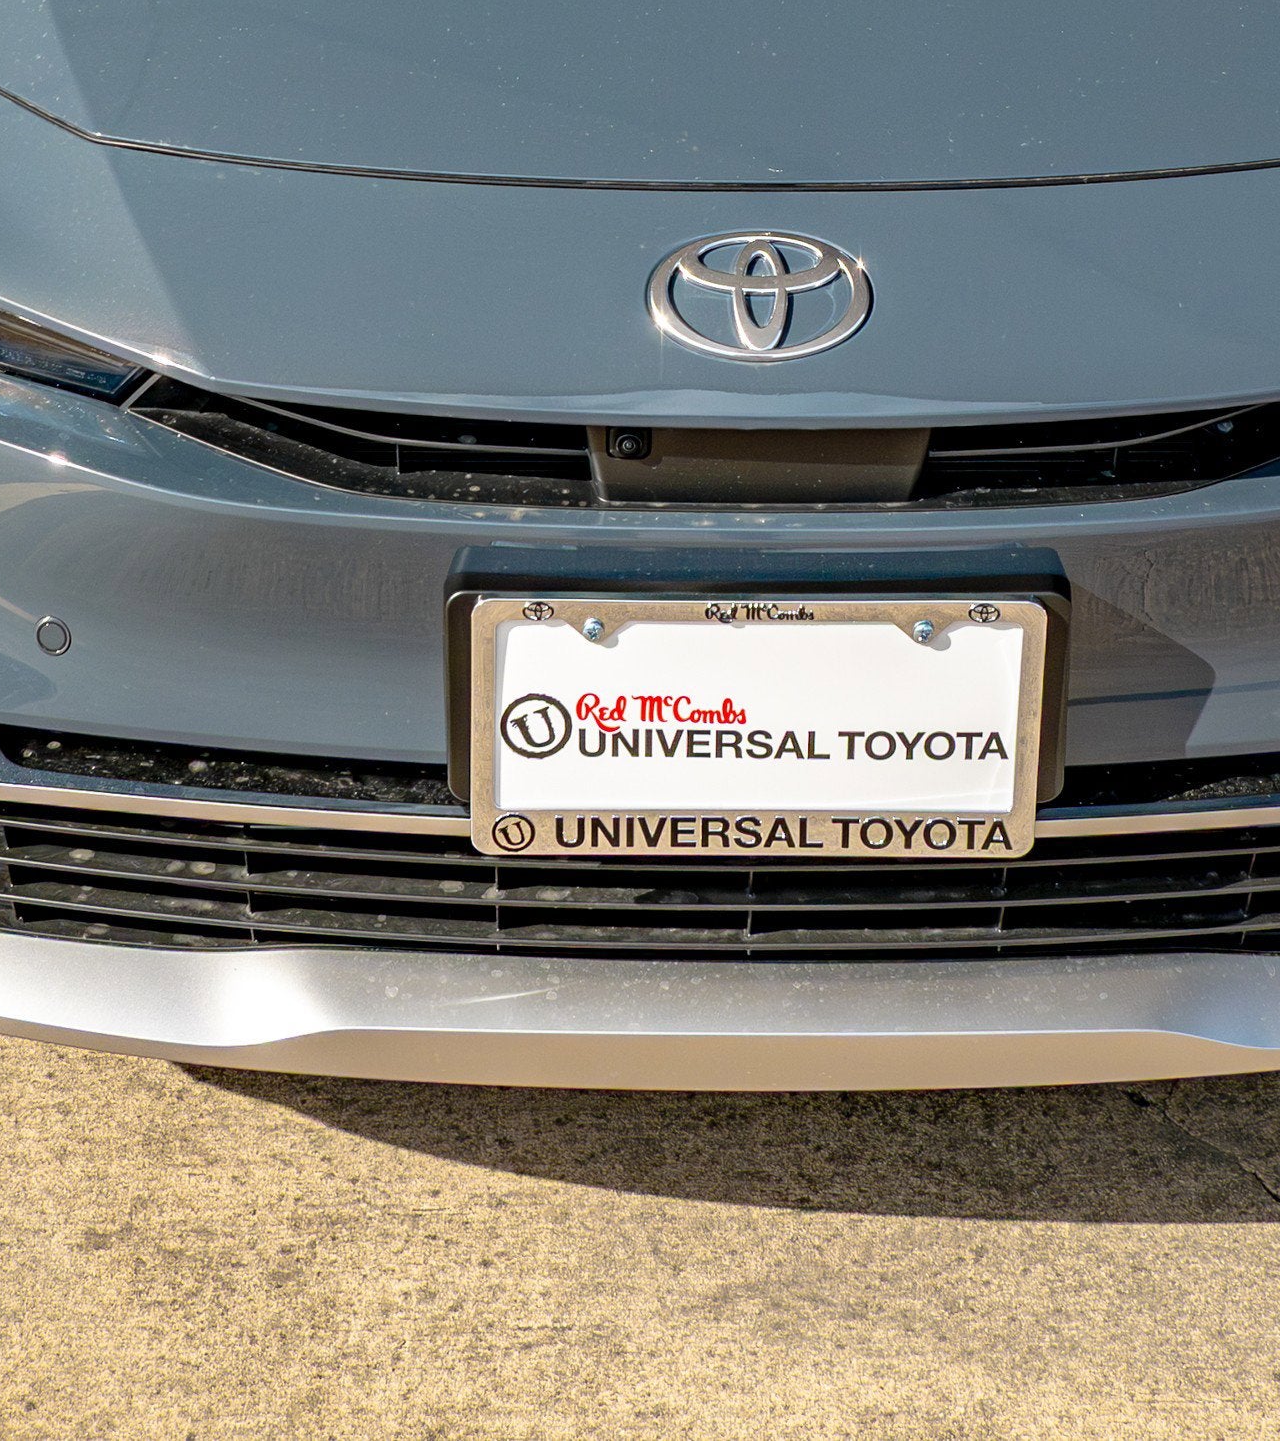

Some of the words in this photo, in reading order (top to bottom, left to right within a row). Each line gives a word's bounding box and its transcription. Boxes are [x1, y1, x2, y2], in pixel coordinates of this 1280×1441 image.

[704, 602, 739, 624] Red
[740, 602, 815, 621] McCombs
[575, 692, 628, 733] Red
[631, 694, 748, 726] McCombs
[578, 728, 831, 760] UNIVERSAL
[837, 730, 1010, 760] TOYOTA
[554, 814, 825, 850] UNIVERSAL
[830, 815, 1014, 851] TOYOTA
